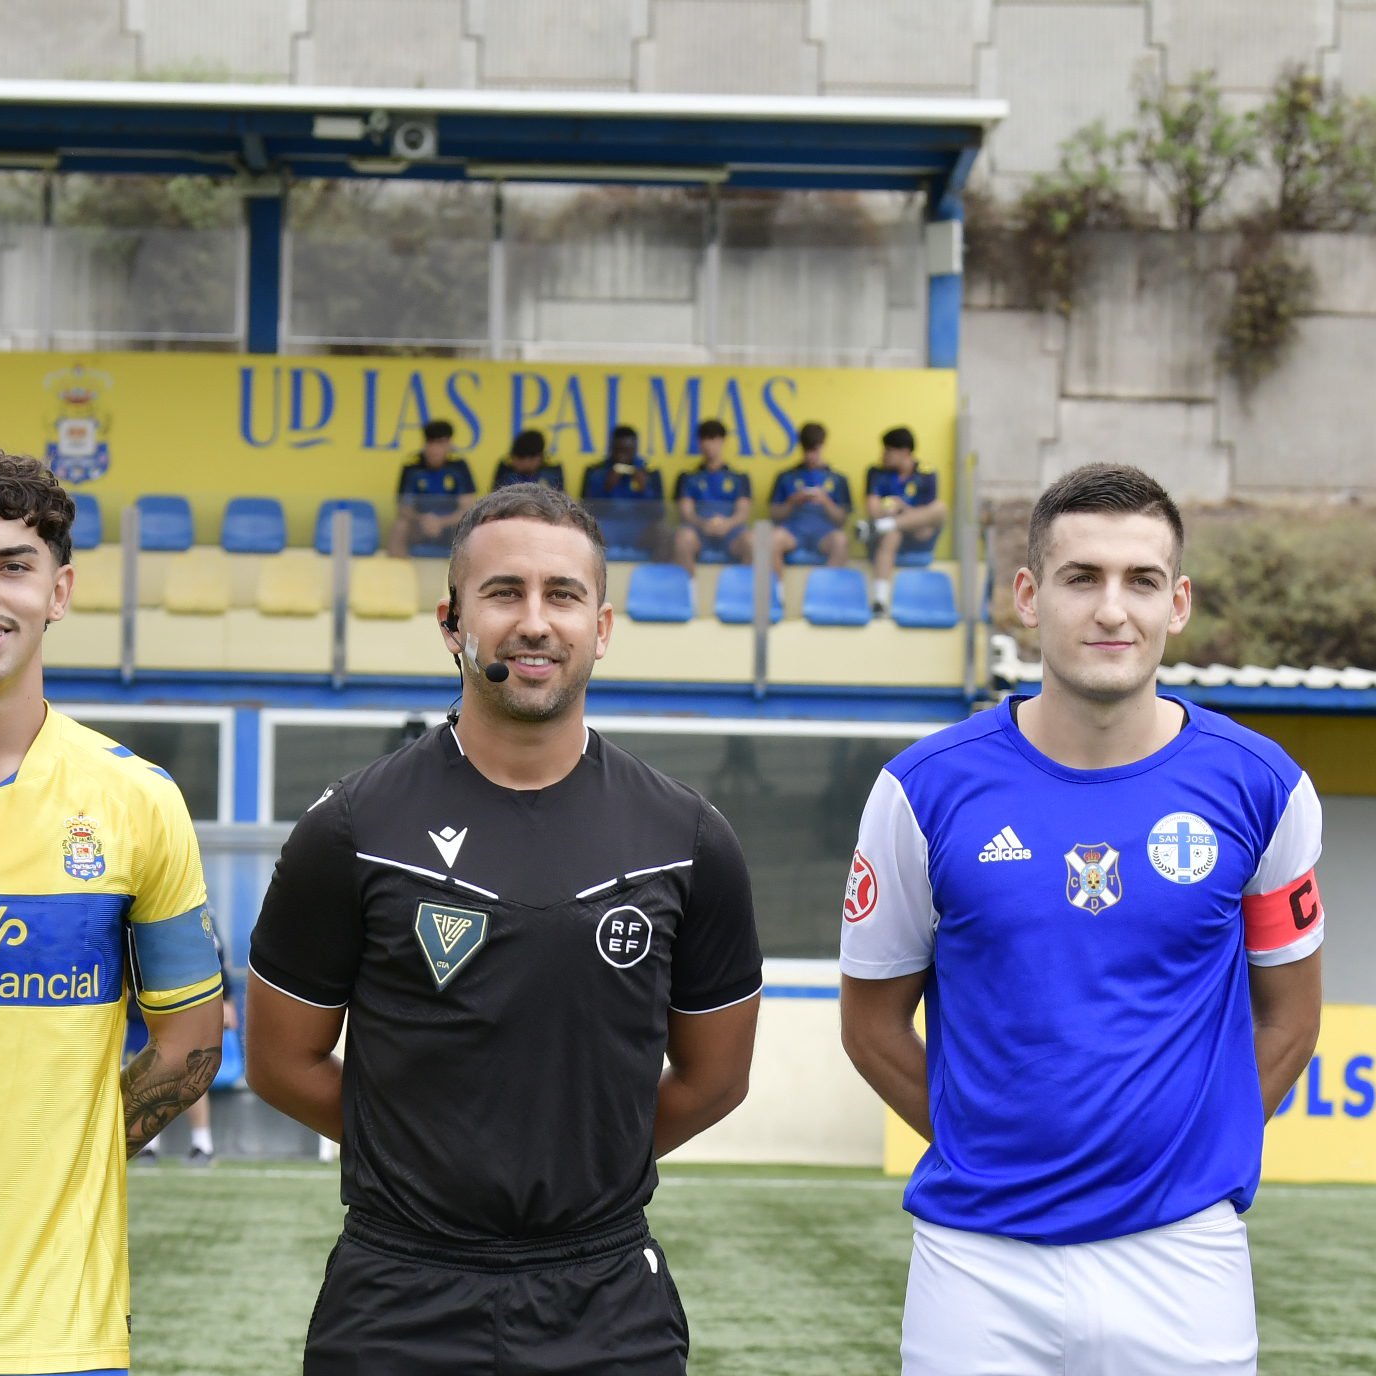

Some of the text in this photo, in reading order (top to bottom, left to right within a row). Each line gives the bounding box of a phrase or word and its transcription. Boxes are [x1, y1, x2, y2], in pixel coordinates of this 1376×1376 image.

[238, 366, 337, 449] UD
[363, 368, 483, 452] LAS
[978, 847, 1033, 863] adidas
[1158, 834, 1212, 845] SAN JOSE
[1289, 878, 1318, 931] C
